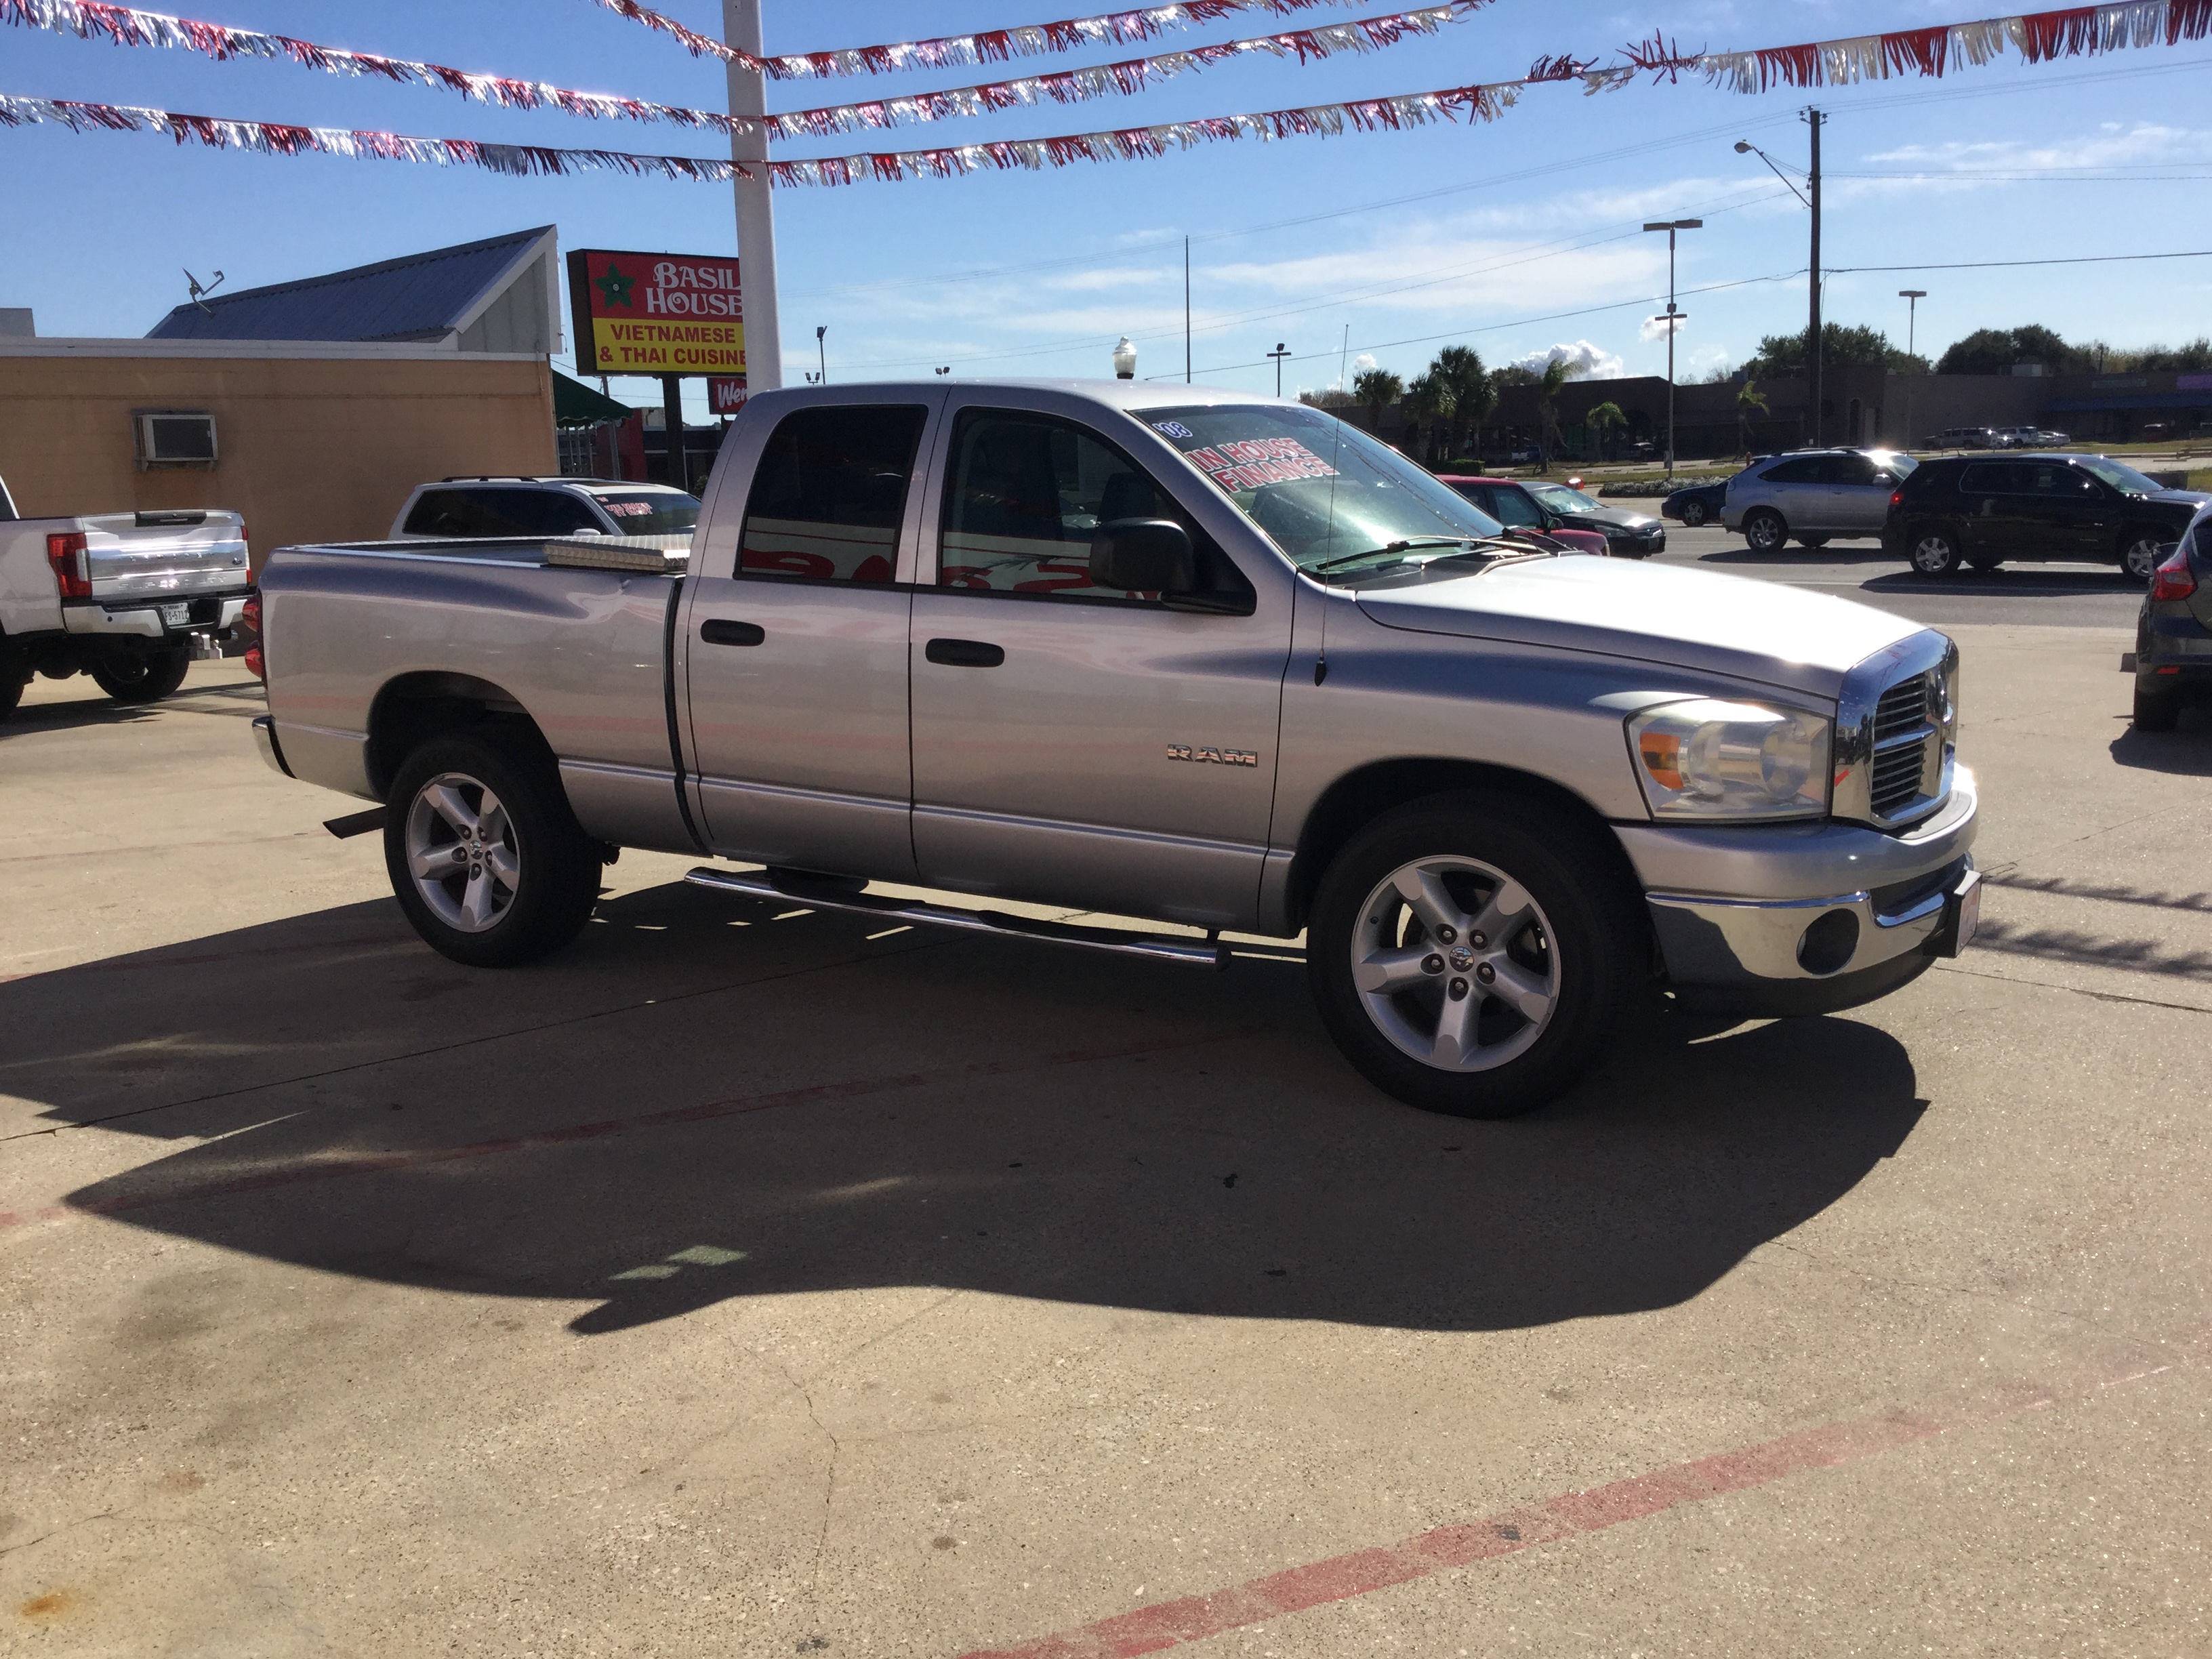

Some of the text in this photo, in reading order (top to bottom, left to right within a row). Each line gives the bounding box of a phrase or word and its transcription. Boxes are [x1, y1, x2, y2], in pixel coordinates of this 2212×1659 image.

[653, 262, 741, 291] BASIL
[646, 287, 743, 316] HOUSE
[610, 325, 736, 344] VIETNAMESE
[600, 346, 613, 363] &
[620, 346, 666, 364] THAI
[1152, 422, 1193, 438] '08
[1184, 437, 1315, 472] IN HOUSE
[1210, 457, 1340, 493] FINANCE
[1167, 743, 1258, 767] RAM
